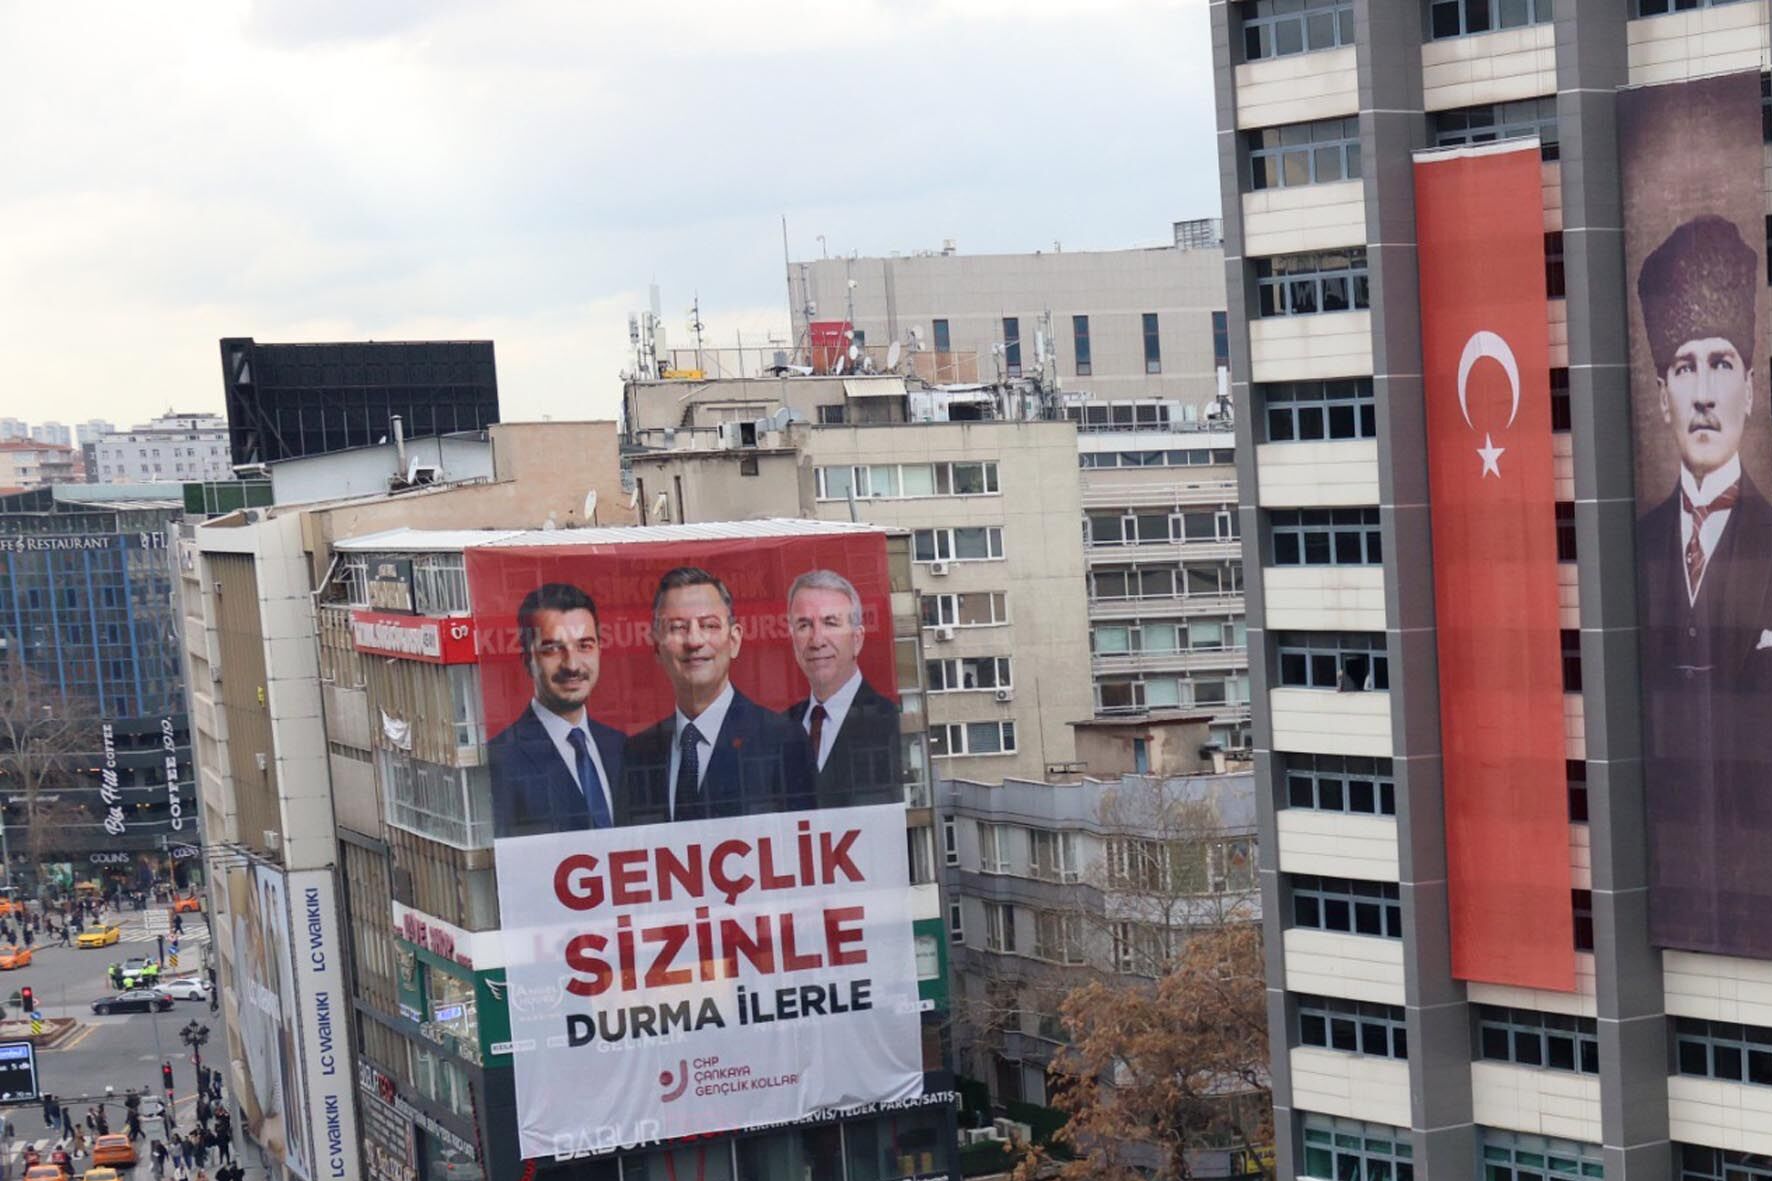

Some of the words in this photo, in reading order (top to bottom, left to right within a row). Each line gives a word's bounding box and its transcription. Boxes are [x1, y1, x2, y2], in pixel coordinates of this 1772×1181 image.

[27, 536, 110, 550] RESTAURANT
[553, 820, 866, 911] GENÇLİK
[313, 951, 326, 972] LC
[564, 905, 868, 997] SİZİNLE
[566, 996, 726, 1047] DURMA
[737, 978, 874, 1025] İLERLE
[322, 1054, 335, 1076] LC
[693, 1056, 720, 1069] CHP
[694, 1065, 751, 1083] ÇANKAYA
[695, 1078, 750, 1097] GENÇLİK
[331, 1155, 345, 1178] LC
